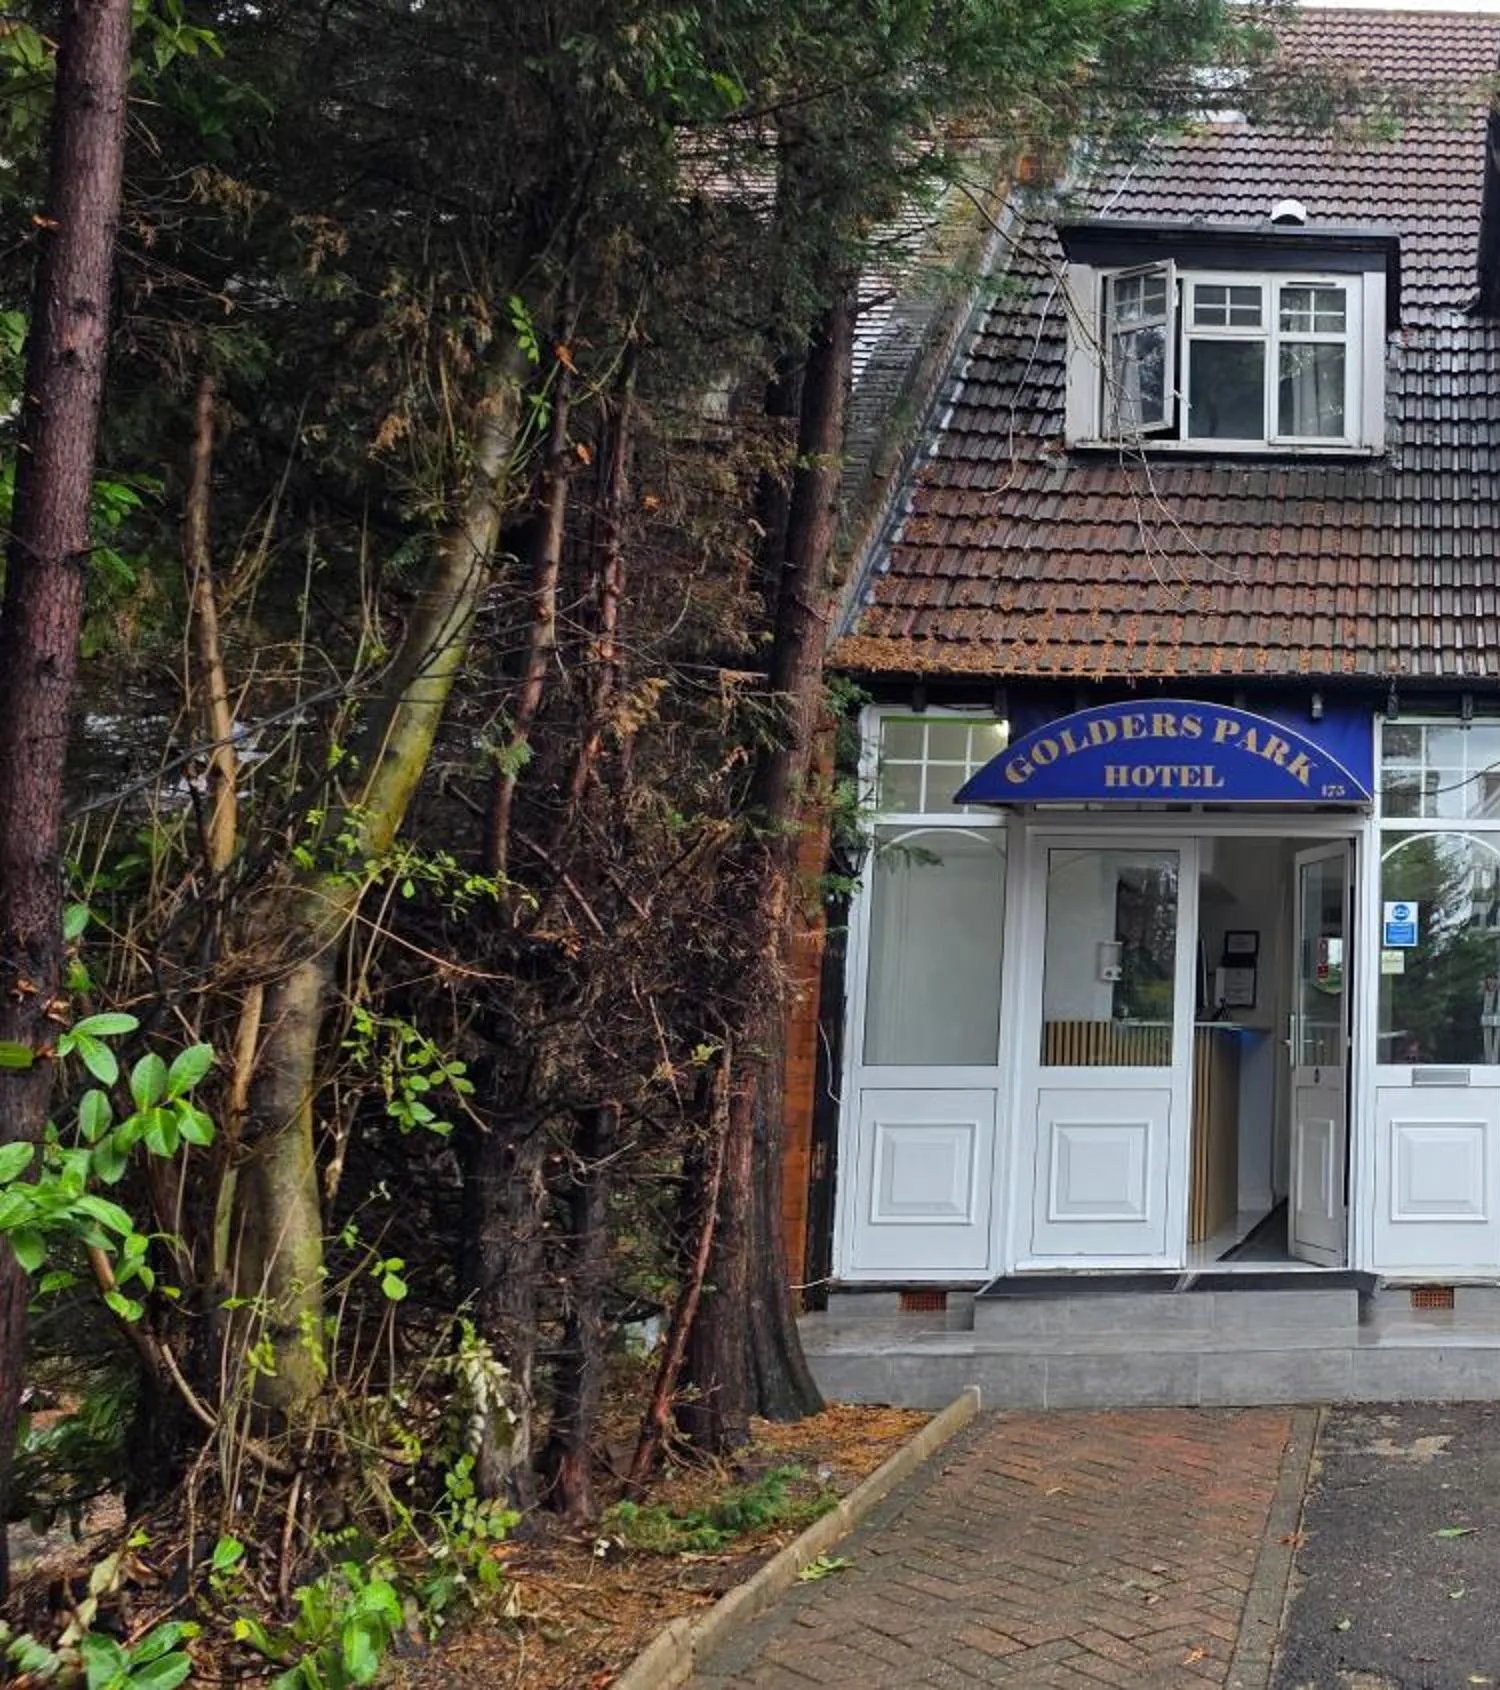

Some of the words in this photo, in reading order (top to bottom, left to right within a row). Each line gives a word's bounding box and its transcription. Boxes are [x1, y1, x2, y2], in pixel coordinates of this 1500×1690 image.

[1005, 713, 1202, 785] GOLDERS
[1213, 717, 1319, 786] PARK
[1104, 765, 1224, 788] HOTEL
[1321, 784, 1345, 797] 175
